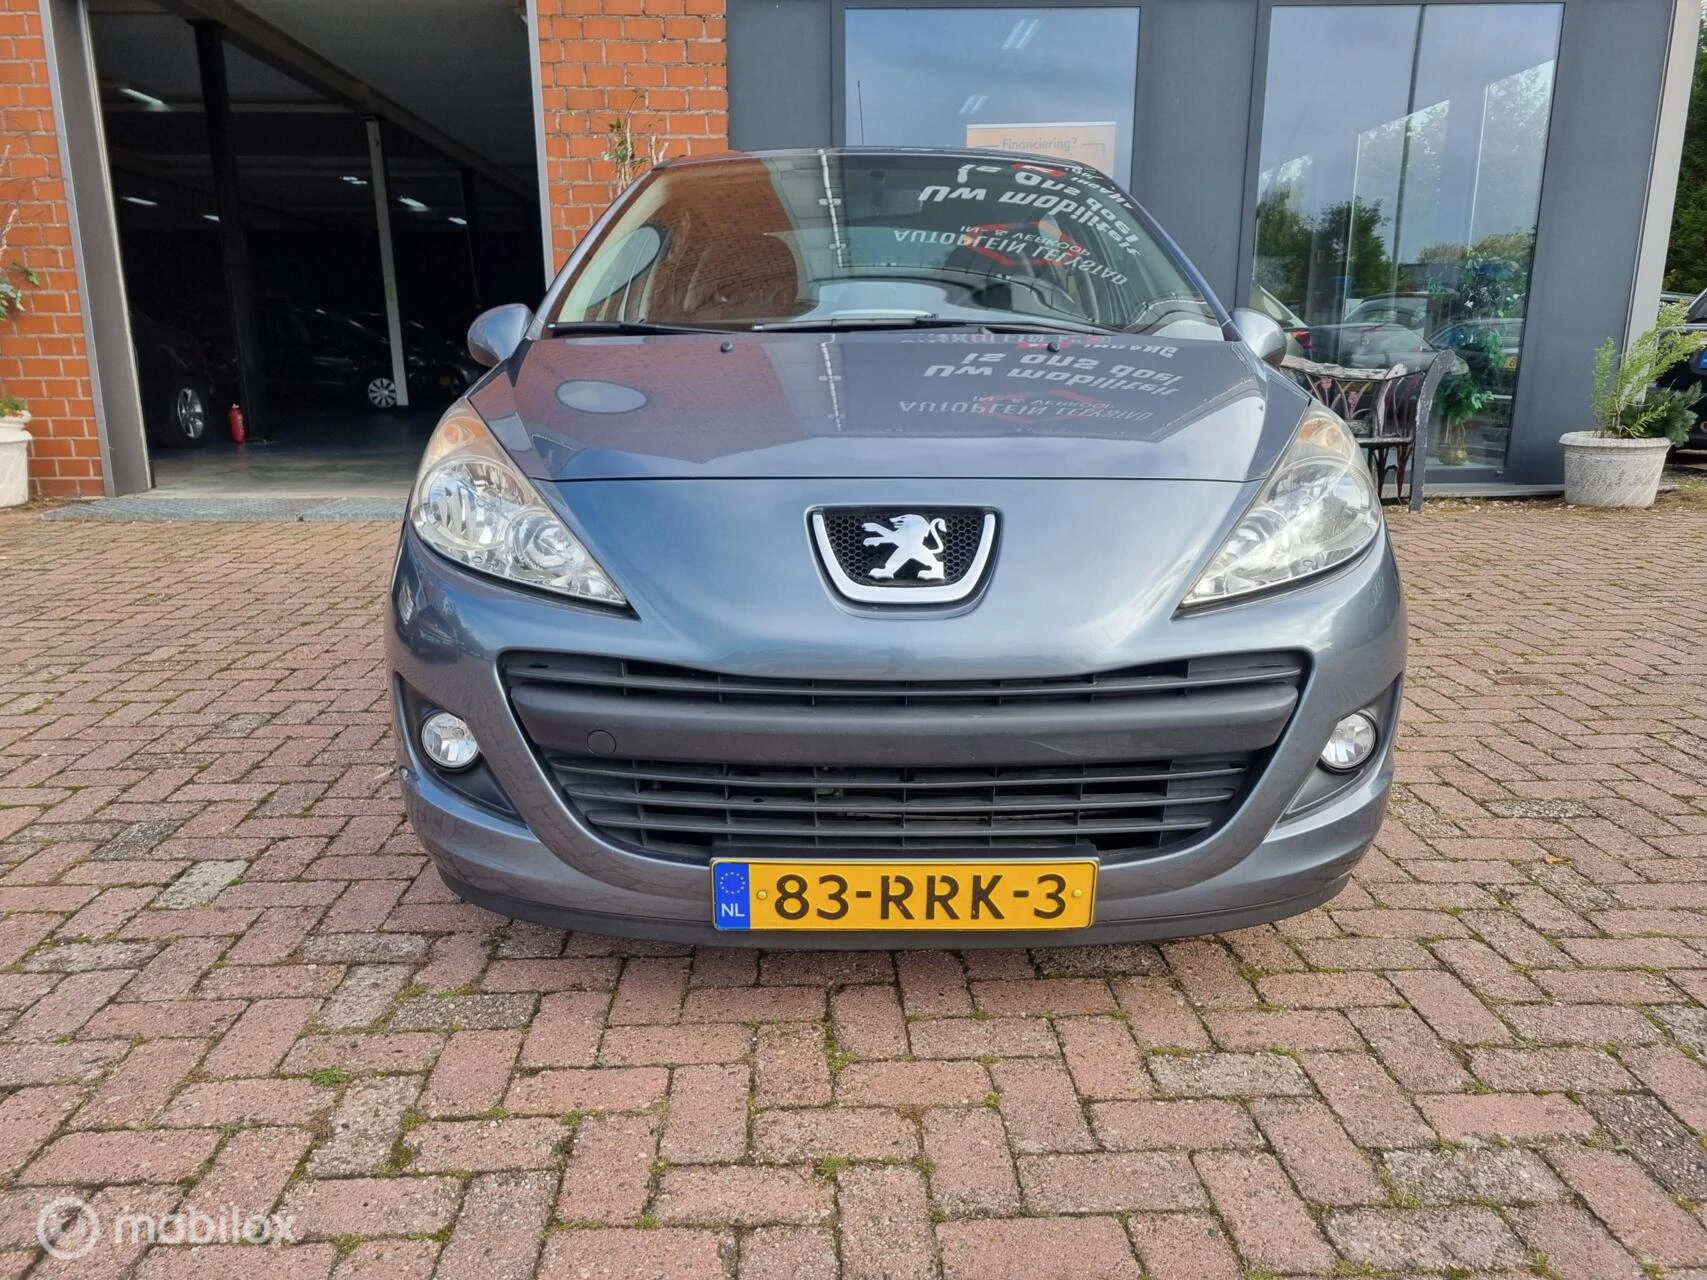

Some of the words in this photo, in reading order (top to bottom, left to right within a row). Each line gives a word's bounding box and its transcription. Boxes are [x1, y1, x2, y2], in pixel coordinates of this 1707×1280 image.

[1002, 137, 1078, 152] Financiering?
[721, 904, 746, 918] NL
[774, 873, 1067, 920] 83-RRK-3
